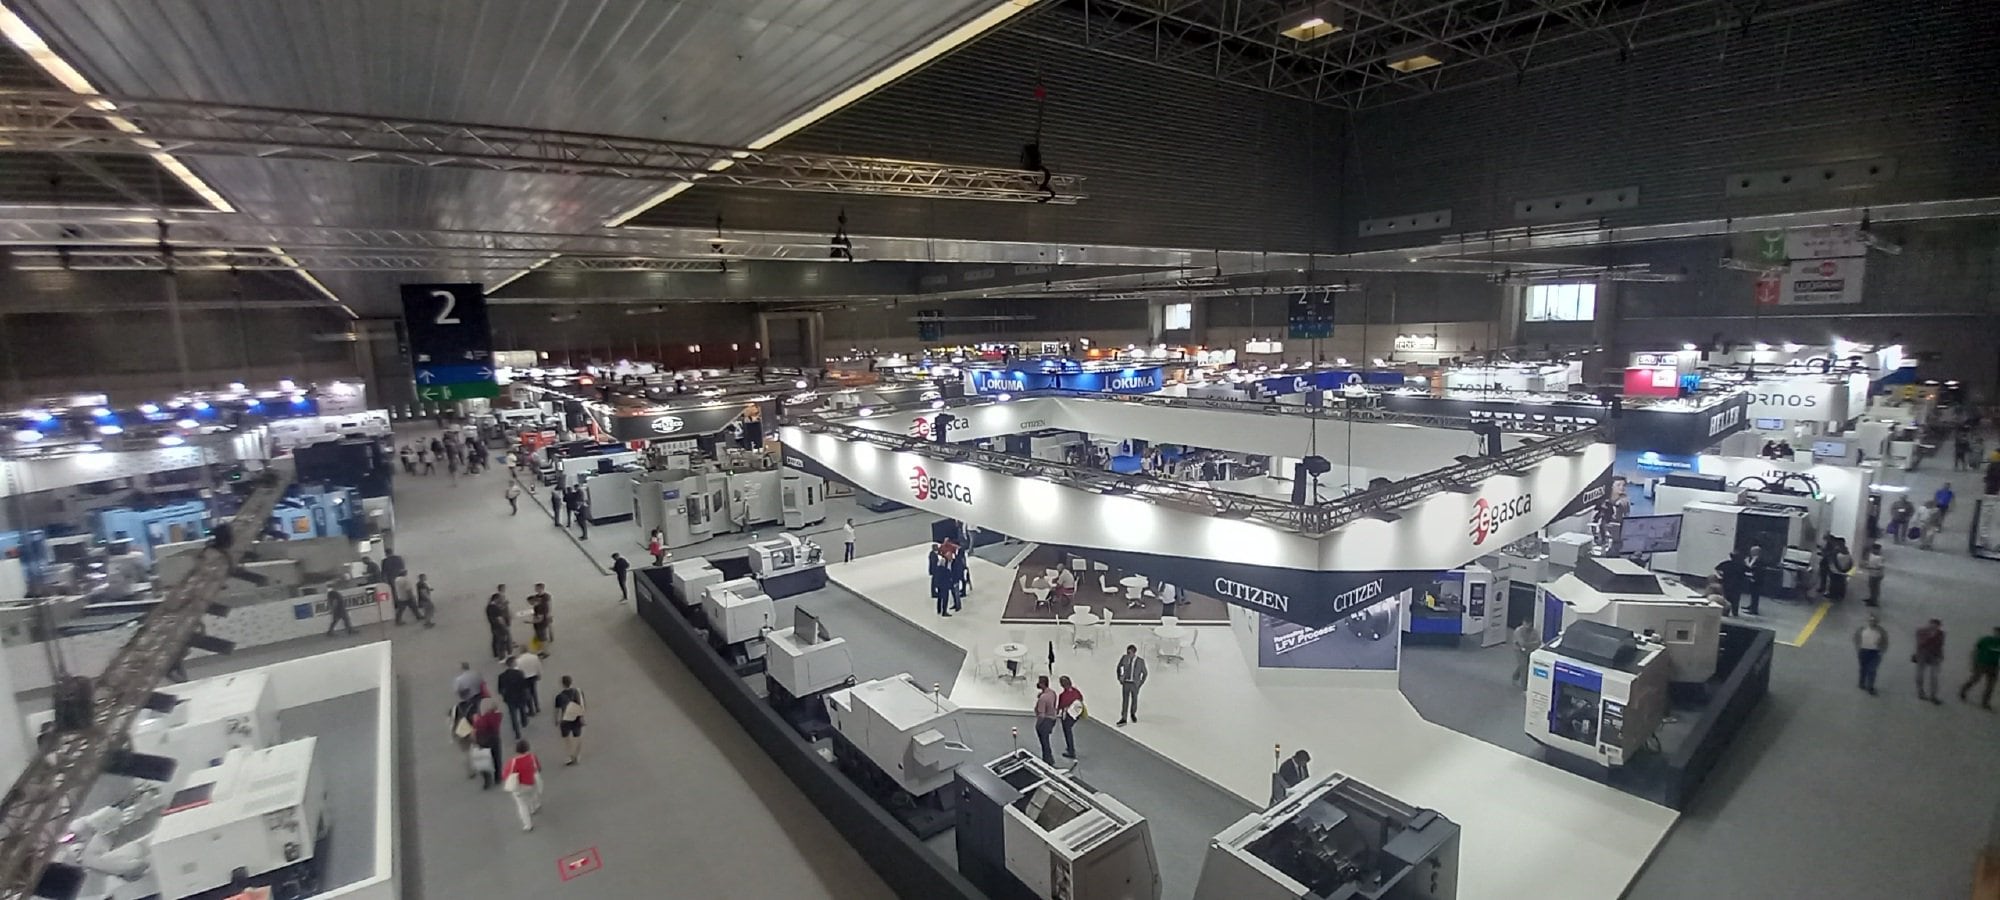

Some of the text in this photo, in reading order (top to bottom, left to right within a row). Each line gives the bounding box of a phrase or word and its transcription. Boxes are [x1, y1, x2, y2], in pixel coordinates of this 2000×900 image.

[431, 290, 460, 324] 2
[987, 378, 1024, 391] OKUMA
[1112, 376, 1154, 390] OKUMA
[919, 475, 973, 504] egasca
[1480, 493, 1532, 534] egasca
[1215, 577, 1289, 612] CITIZEN
[1333, 579, 1383, 612] CITIZEN
[1275, 638, 1295, 651] LFV
